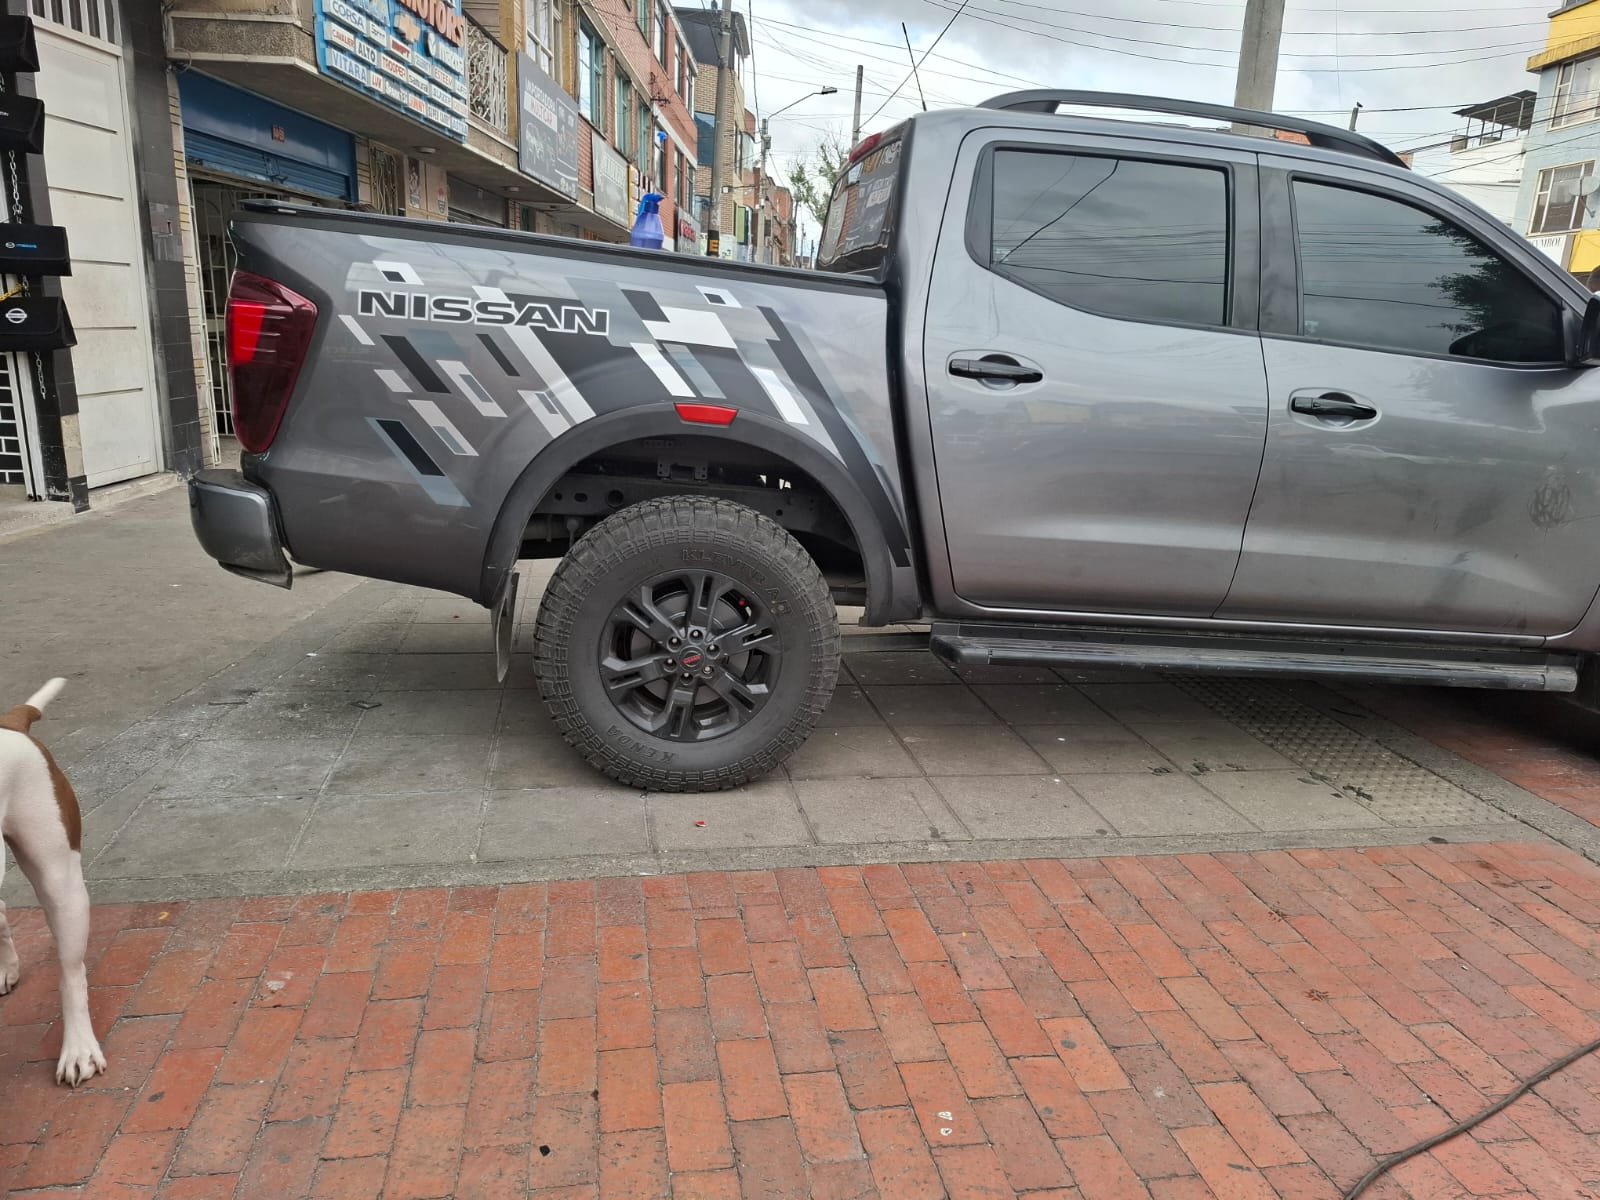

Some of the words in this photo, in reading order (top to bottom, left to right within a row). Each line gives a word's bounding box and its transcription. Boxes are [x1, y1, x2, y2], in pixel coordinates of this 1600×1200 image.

[333, 1, 364, 29] CORSA
[398, 0, 465, 48] OTORS
[333, 49, 367, 82] VITARA
[358, 42, 376, 63] ALTO
[382, 57, 406, 79] TROOPER
[358, 289, 609, 336] NISSAN
[607, 724, 680, 765] KENDA
